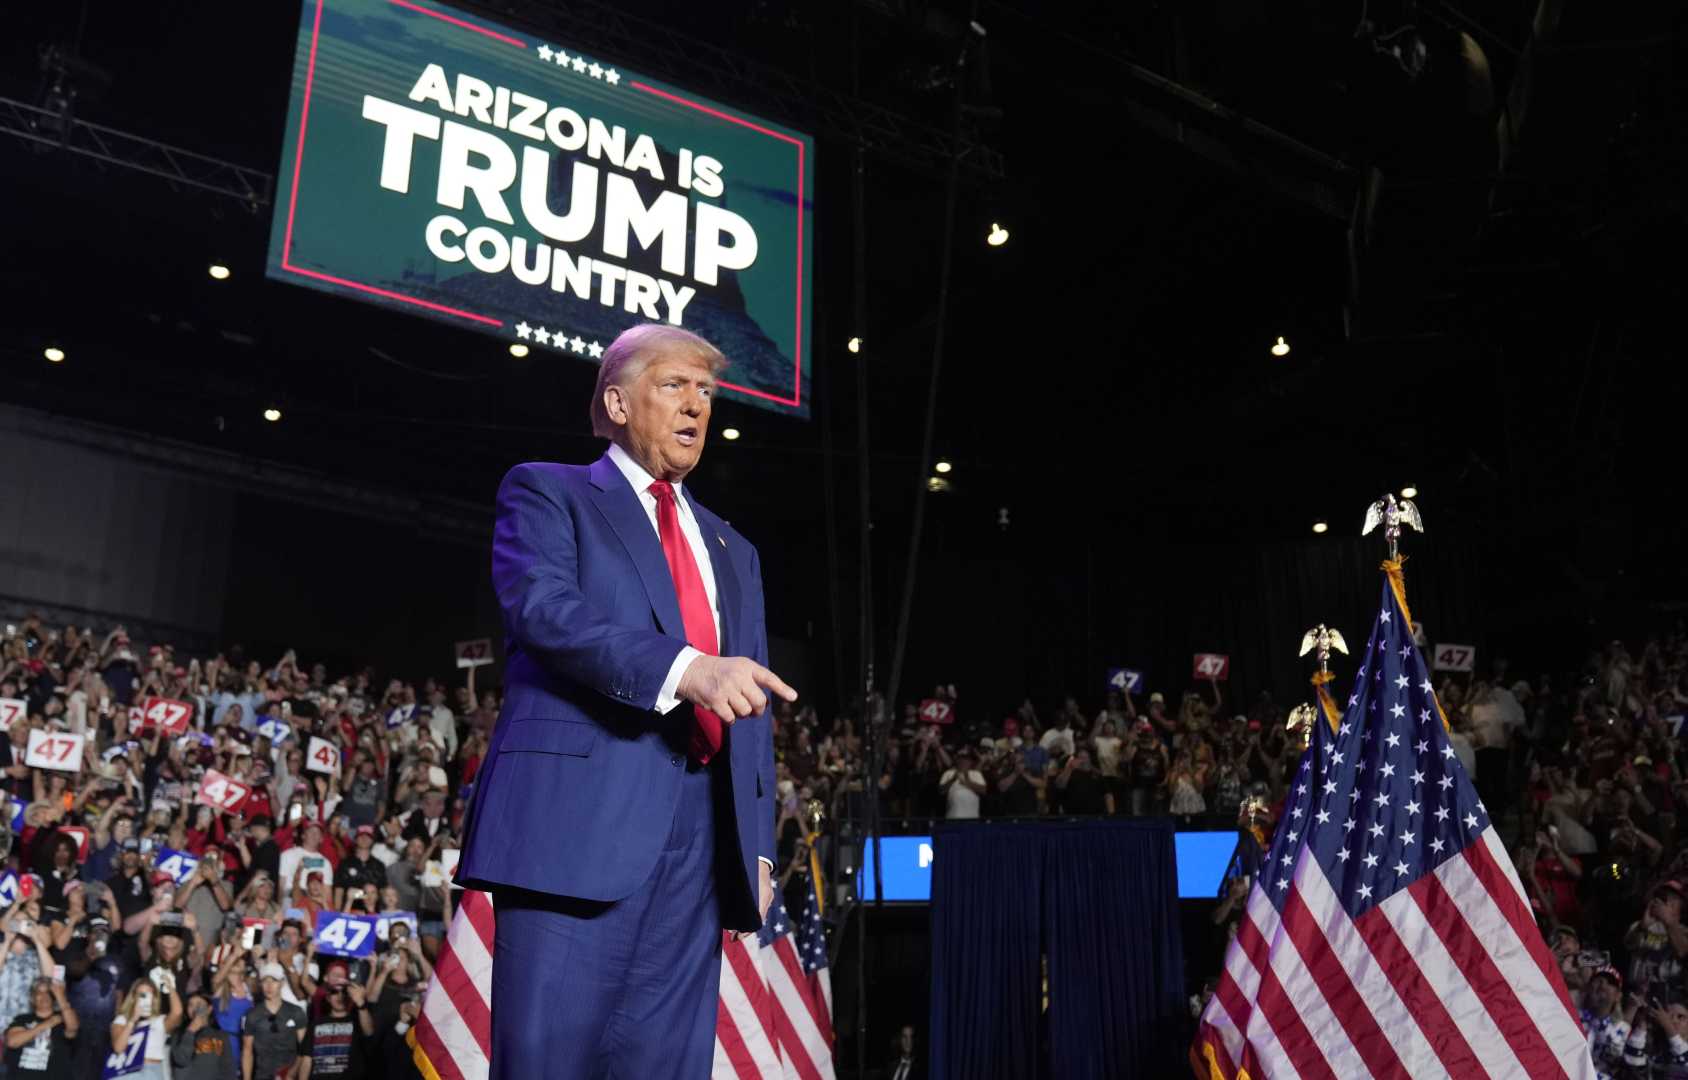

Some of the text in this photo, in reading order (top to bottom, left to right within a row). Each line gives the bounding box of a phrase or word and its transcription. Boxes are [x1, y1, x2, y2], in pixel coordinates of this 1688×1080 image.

[408, 63, 725, 198] ARIZONA IS
[361, 94, 758, 287] TRUMP
[424, 214, 696, 326] COUNTRY
[1198, 657, 1225, 675] 47
[1437, 649, 1470, 667] 47
[1110, 670, 1139, 688] 47
[4, 705, 19, 724] 7
[147, 701, 186, 726] 47
[388, 704, 416, 724] 47
[923, 702, 950, 720] 47
[258, 720, 290, 744] 47
[1664, 715, 1684, 736] 7
[35, 739, 75, 762] 47
[314, 746, 336, 768] 47
[204, 780, 246, 808] 47
[159, 854, 198, 883] 47
[319, 917, 371, 950] 47
[106, 1030, 146, 1070] 47
